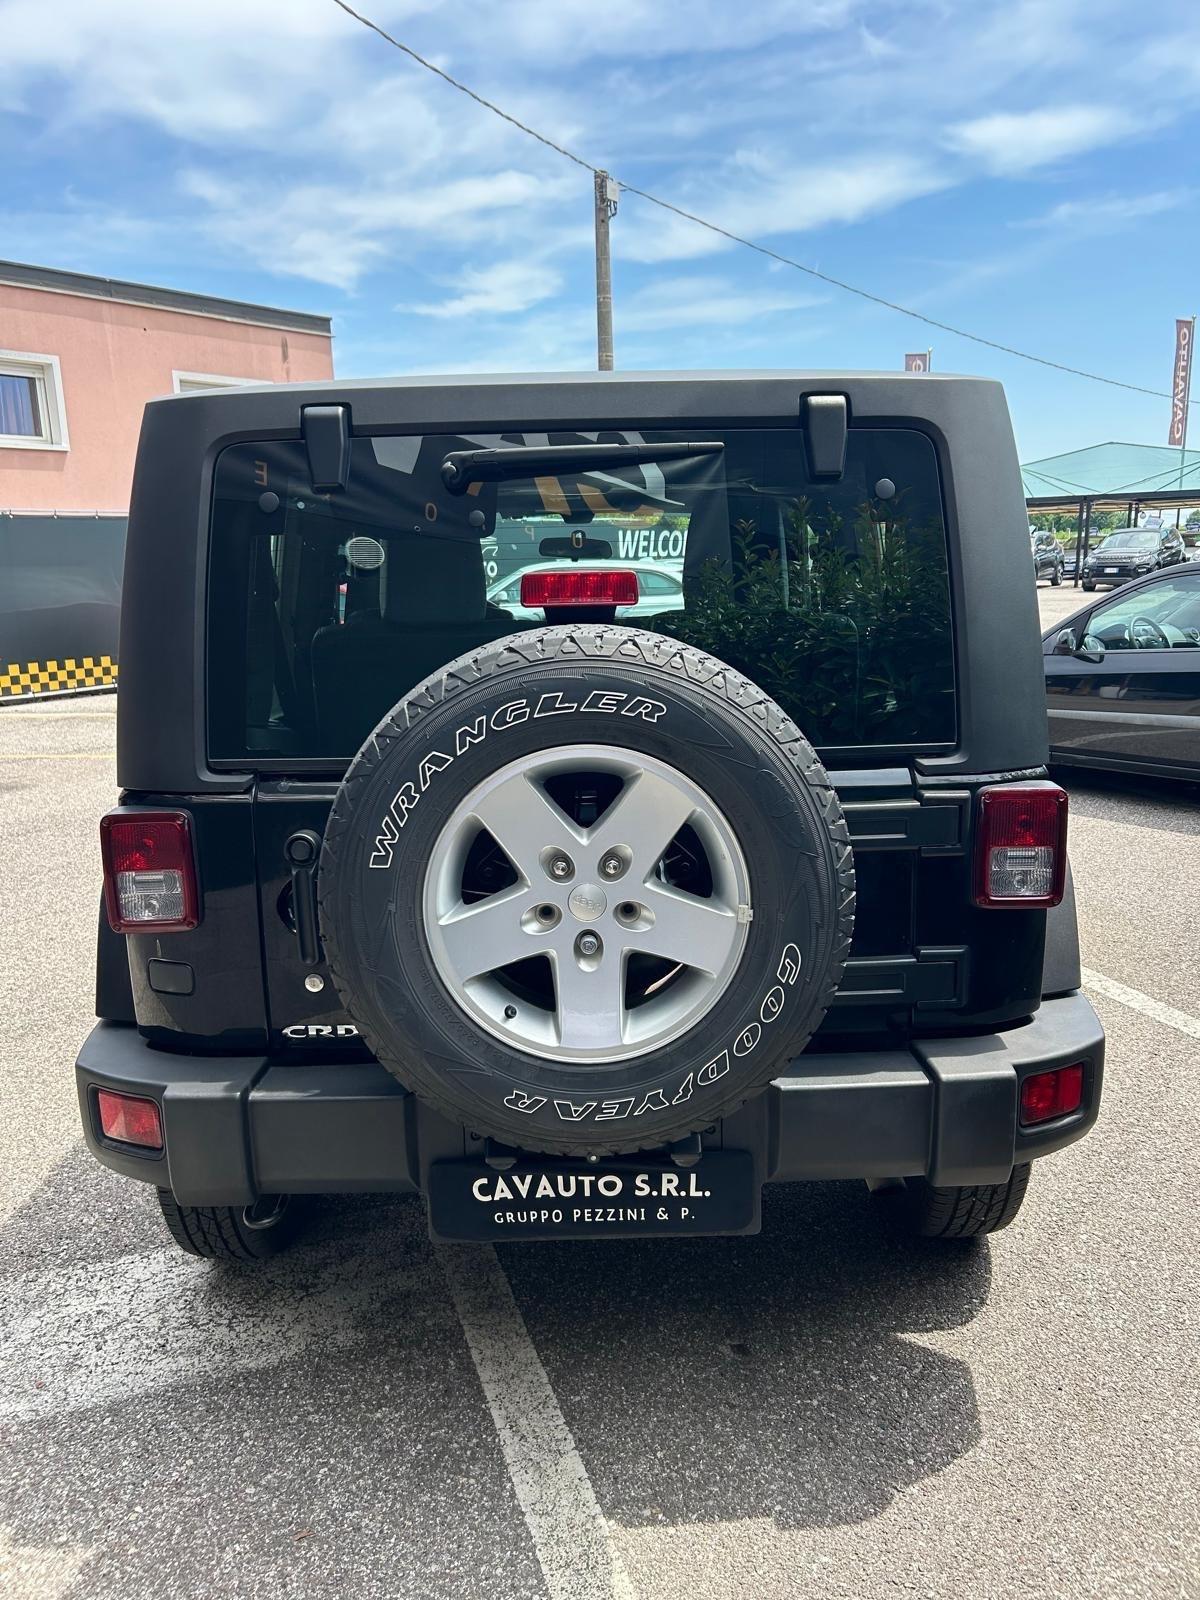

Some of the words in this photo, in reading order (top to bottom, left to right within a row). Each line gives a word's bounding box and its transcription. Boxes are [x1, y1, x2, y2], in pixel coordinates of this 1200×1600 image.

[618, 529, 688, 559] WELCO
[369, 690, 667, 870] WRANGLER
[281, 1024, 360, 1038] CRD
[503, 942, 803, 1122] GOODYEAR
[472, 1173, 623, 1202] CAVAUTO
[635, 1173, 711, 1198] S.R.L.
[494, 1208, 563, 1224] GRUPPO
[573, 1207, 646, 1222] PEZZINI
[656, 1207, 669, 1221] &
[681, 1206, 696, 1220] P.
